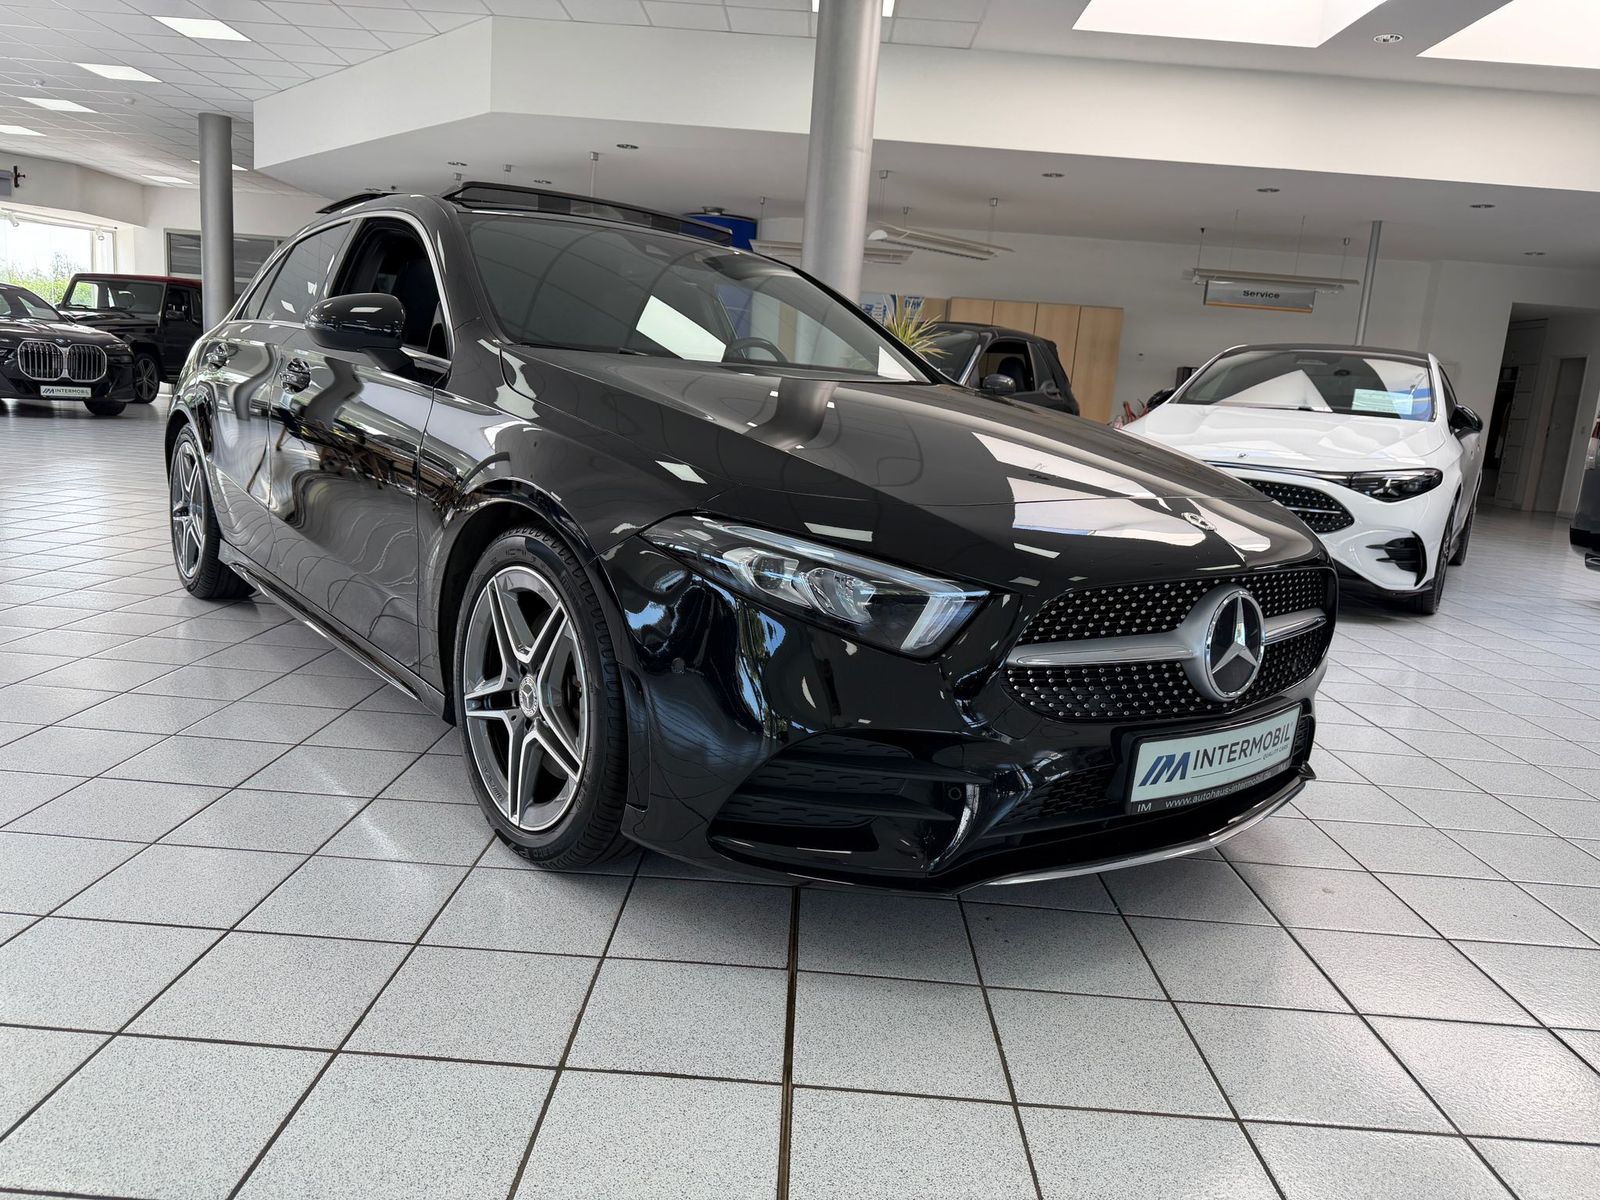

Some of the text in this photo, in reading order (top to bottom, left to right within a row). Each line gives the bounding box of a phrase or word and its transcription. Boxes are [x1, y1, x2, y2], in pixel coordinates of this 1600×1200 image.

[1242, 289, 1280, 299] Service
[55, 388, 90, 396] INTERMOBIL
[1193, 723, 1291, 771] INTERMOBIL
[1137, 802, 1152, 812] IM
